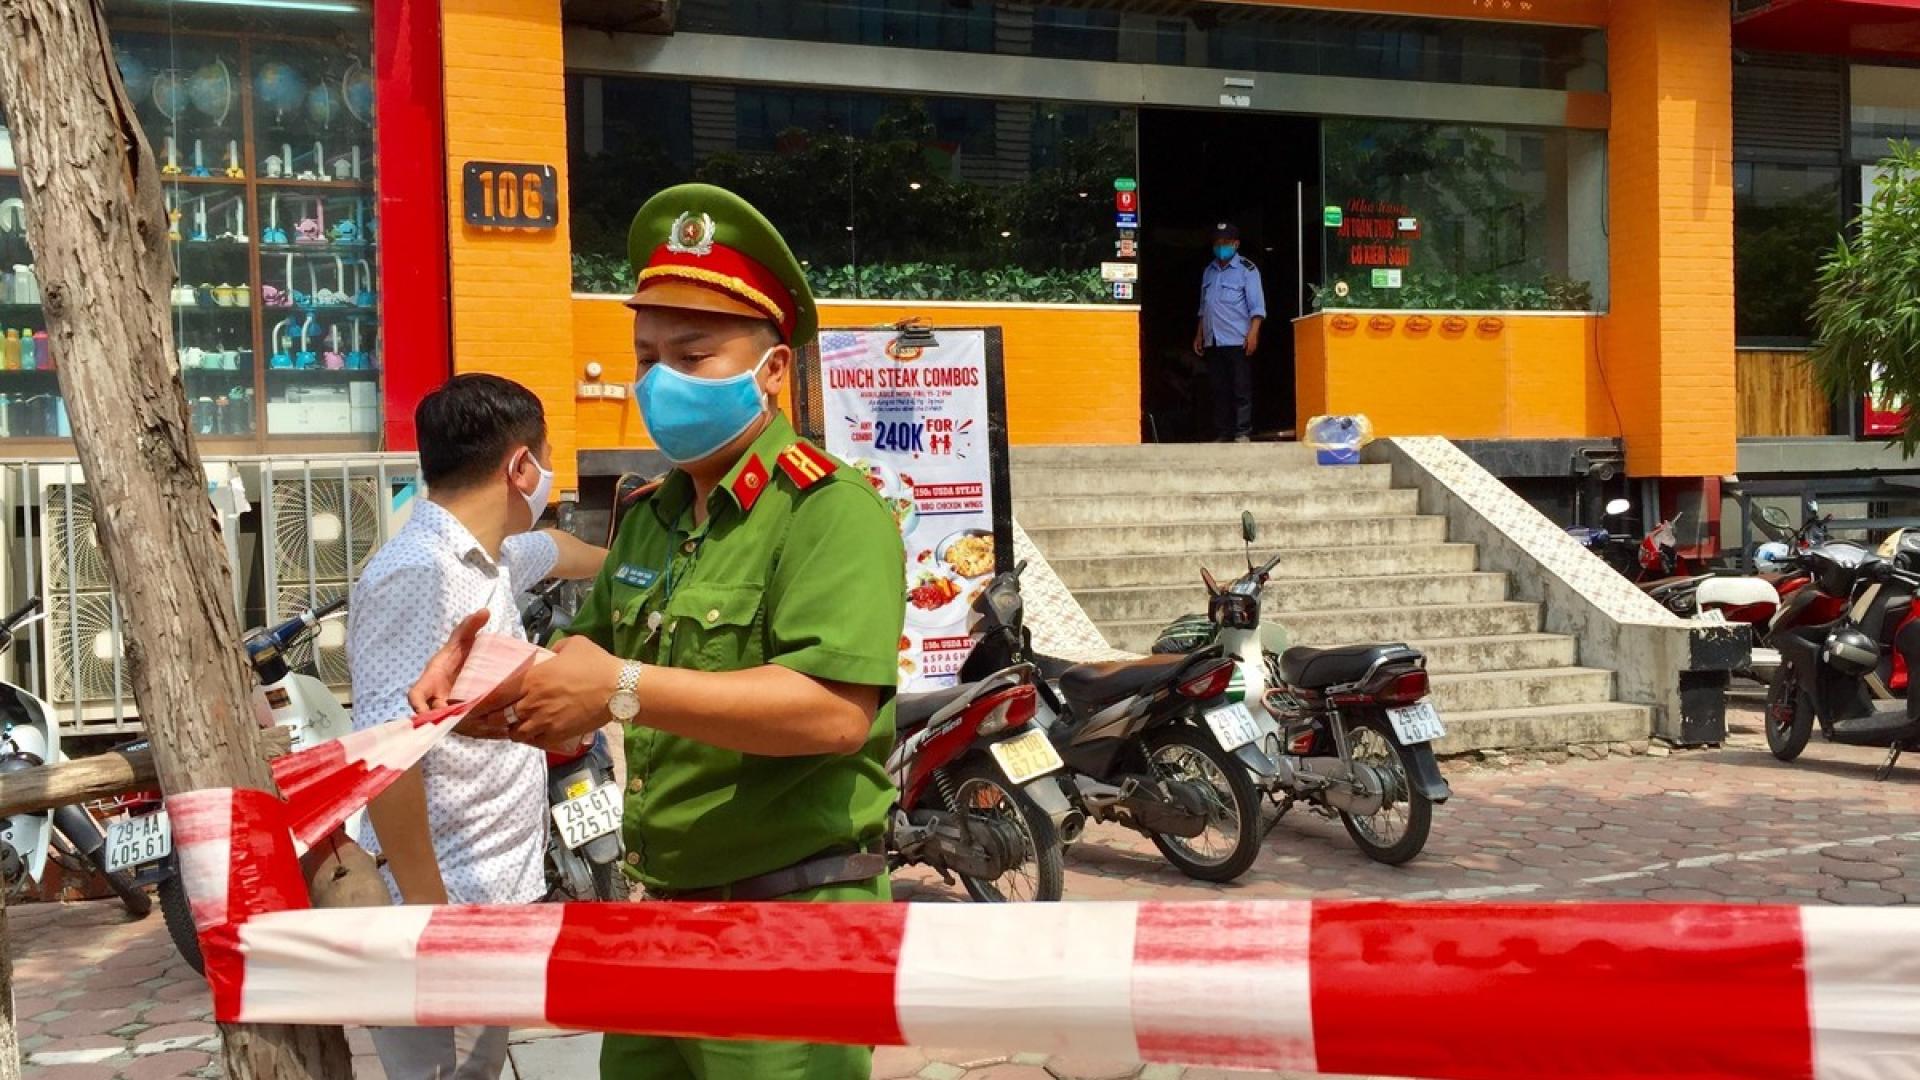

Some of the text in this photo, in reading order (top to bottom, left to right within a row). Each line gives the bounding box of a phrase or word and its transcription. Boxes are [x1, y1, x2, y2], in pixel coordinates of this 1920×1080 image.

[479, 170, 544, 219] 106
[830, 367, 979, 390] LUNCH STEAK COMBOS
[875, 421, 924, 452] 240K
[926, 419, 953, 432] FOR
[932, 486, 954, 496] USDA
[955, 485, 982, 495] STEAK
[921, 502, 935, 510] BBQ
[936, 501, 961, 509] CHICKEN
[963, 500, 984, 508] WINGS
[923, 663, 959, 673] BOLOG
[562, 789, 612, 823] 29-G1
[116, 813, 160, 846] 29-AA
[111, 833, 165, 868] 405.61
